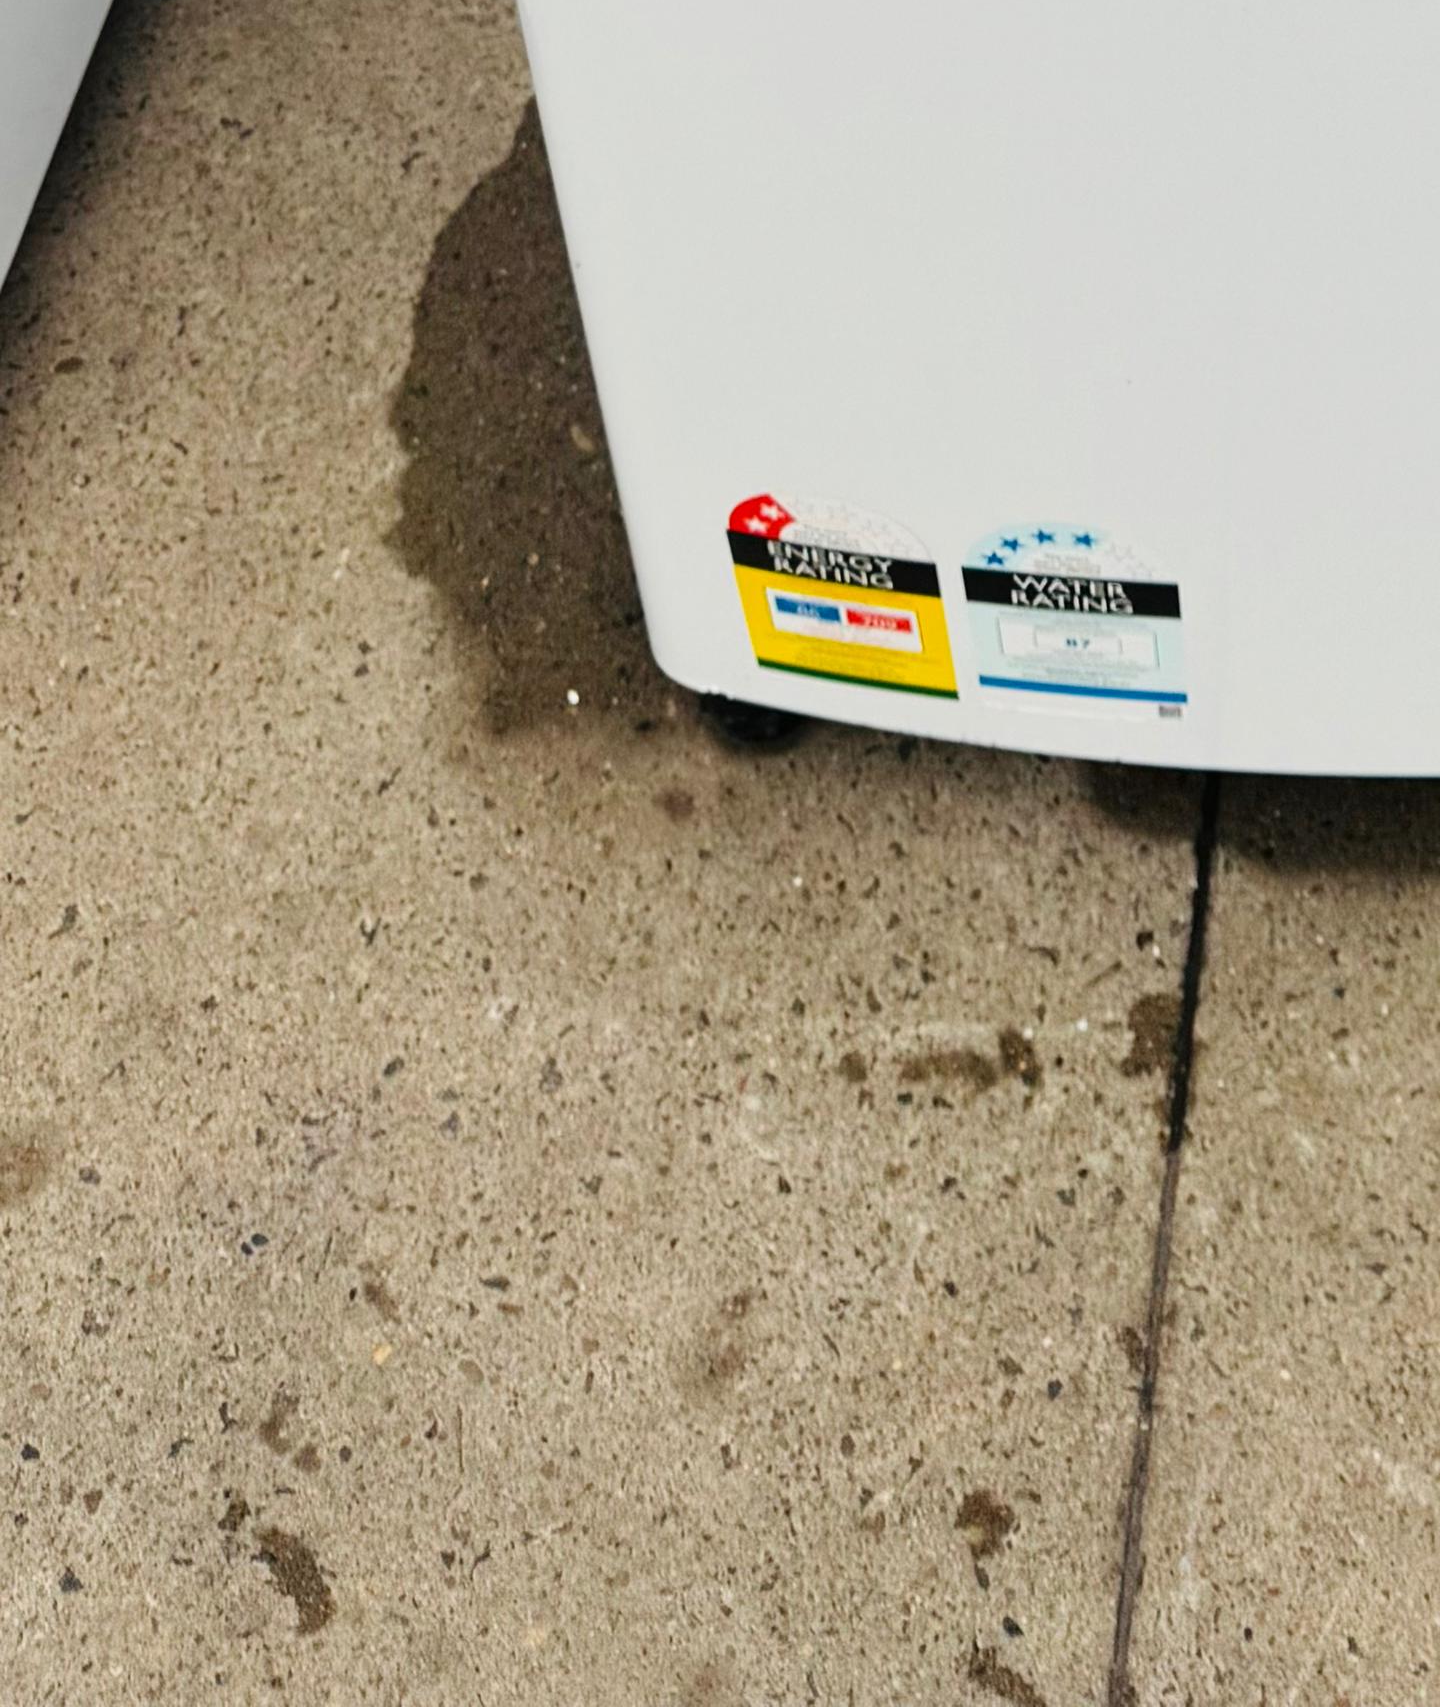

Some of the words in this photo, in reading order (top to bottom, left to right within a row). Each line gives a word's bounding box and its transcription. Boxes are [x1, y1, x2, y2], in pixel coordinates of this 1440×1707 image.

[767, 539, 893, 575] ENERGY
[773, 556, 894, 591] RATING
[1012, 573, 1128, 599] WATER
[1010, 589, 1134, 616] RATING
